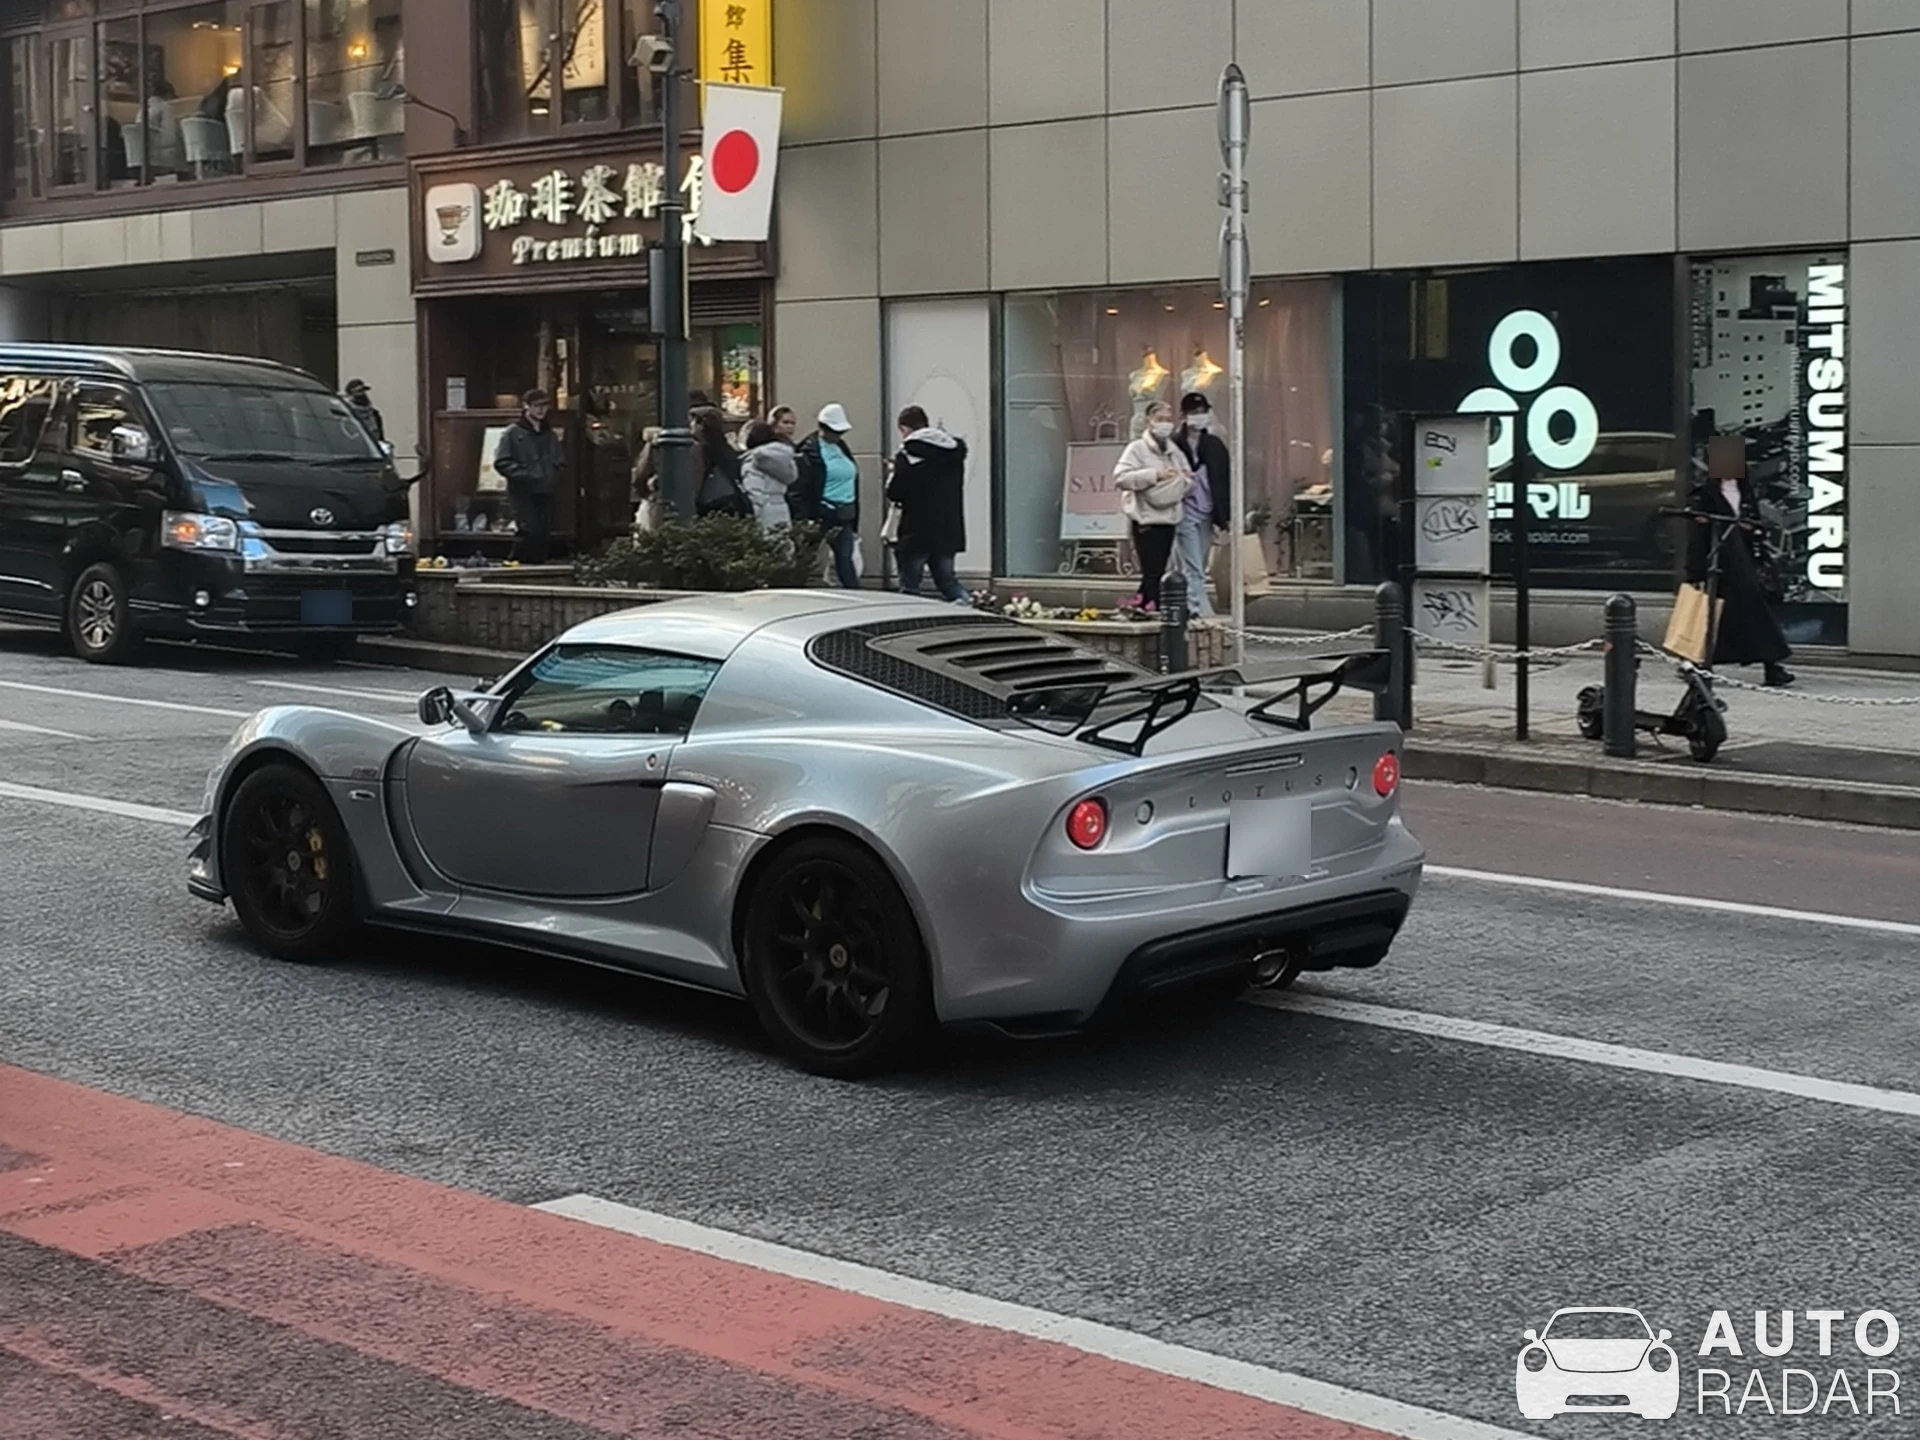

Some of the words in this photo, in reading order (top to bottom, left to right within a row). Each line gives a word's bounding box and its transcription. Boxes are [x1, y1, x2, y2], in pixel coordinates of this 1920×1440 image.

[511, 223, 644, 265] Premium
[1807, 264, 1845, 588] MITSUMARU
[1069, 475, 1119, 494] SAL
[1188, 773, 1324, 809] LOTUS
